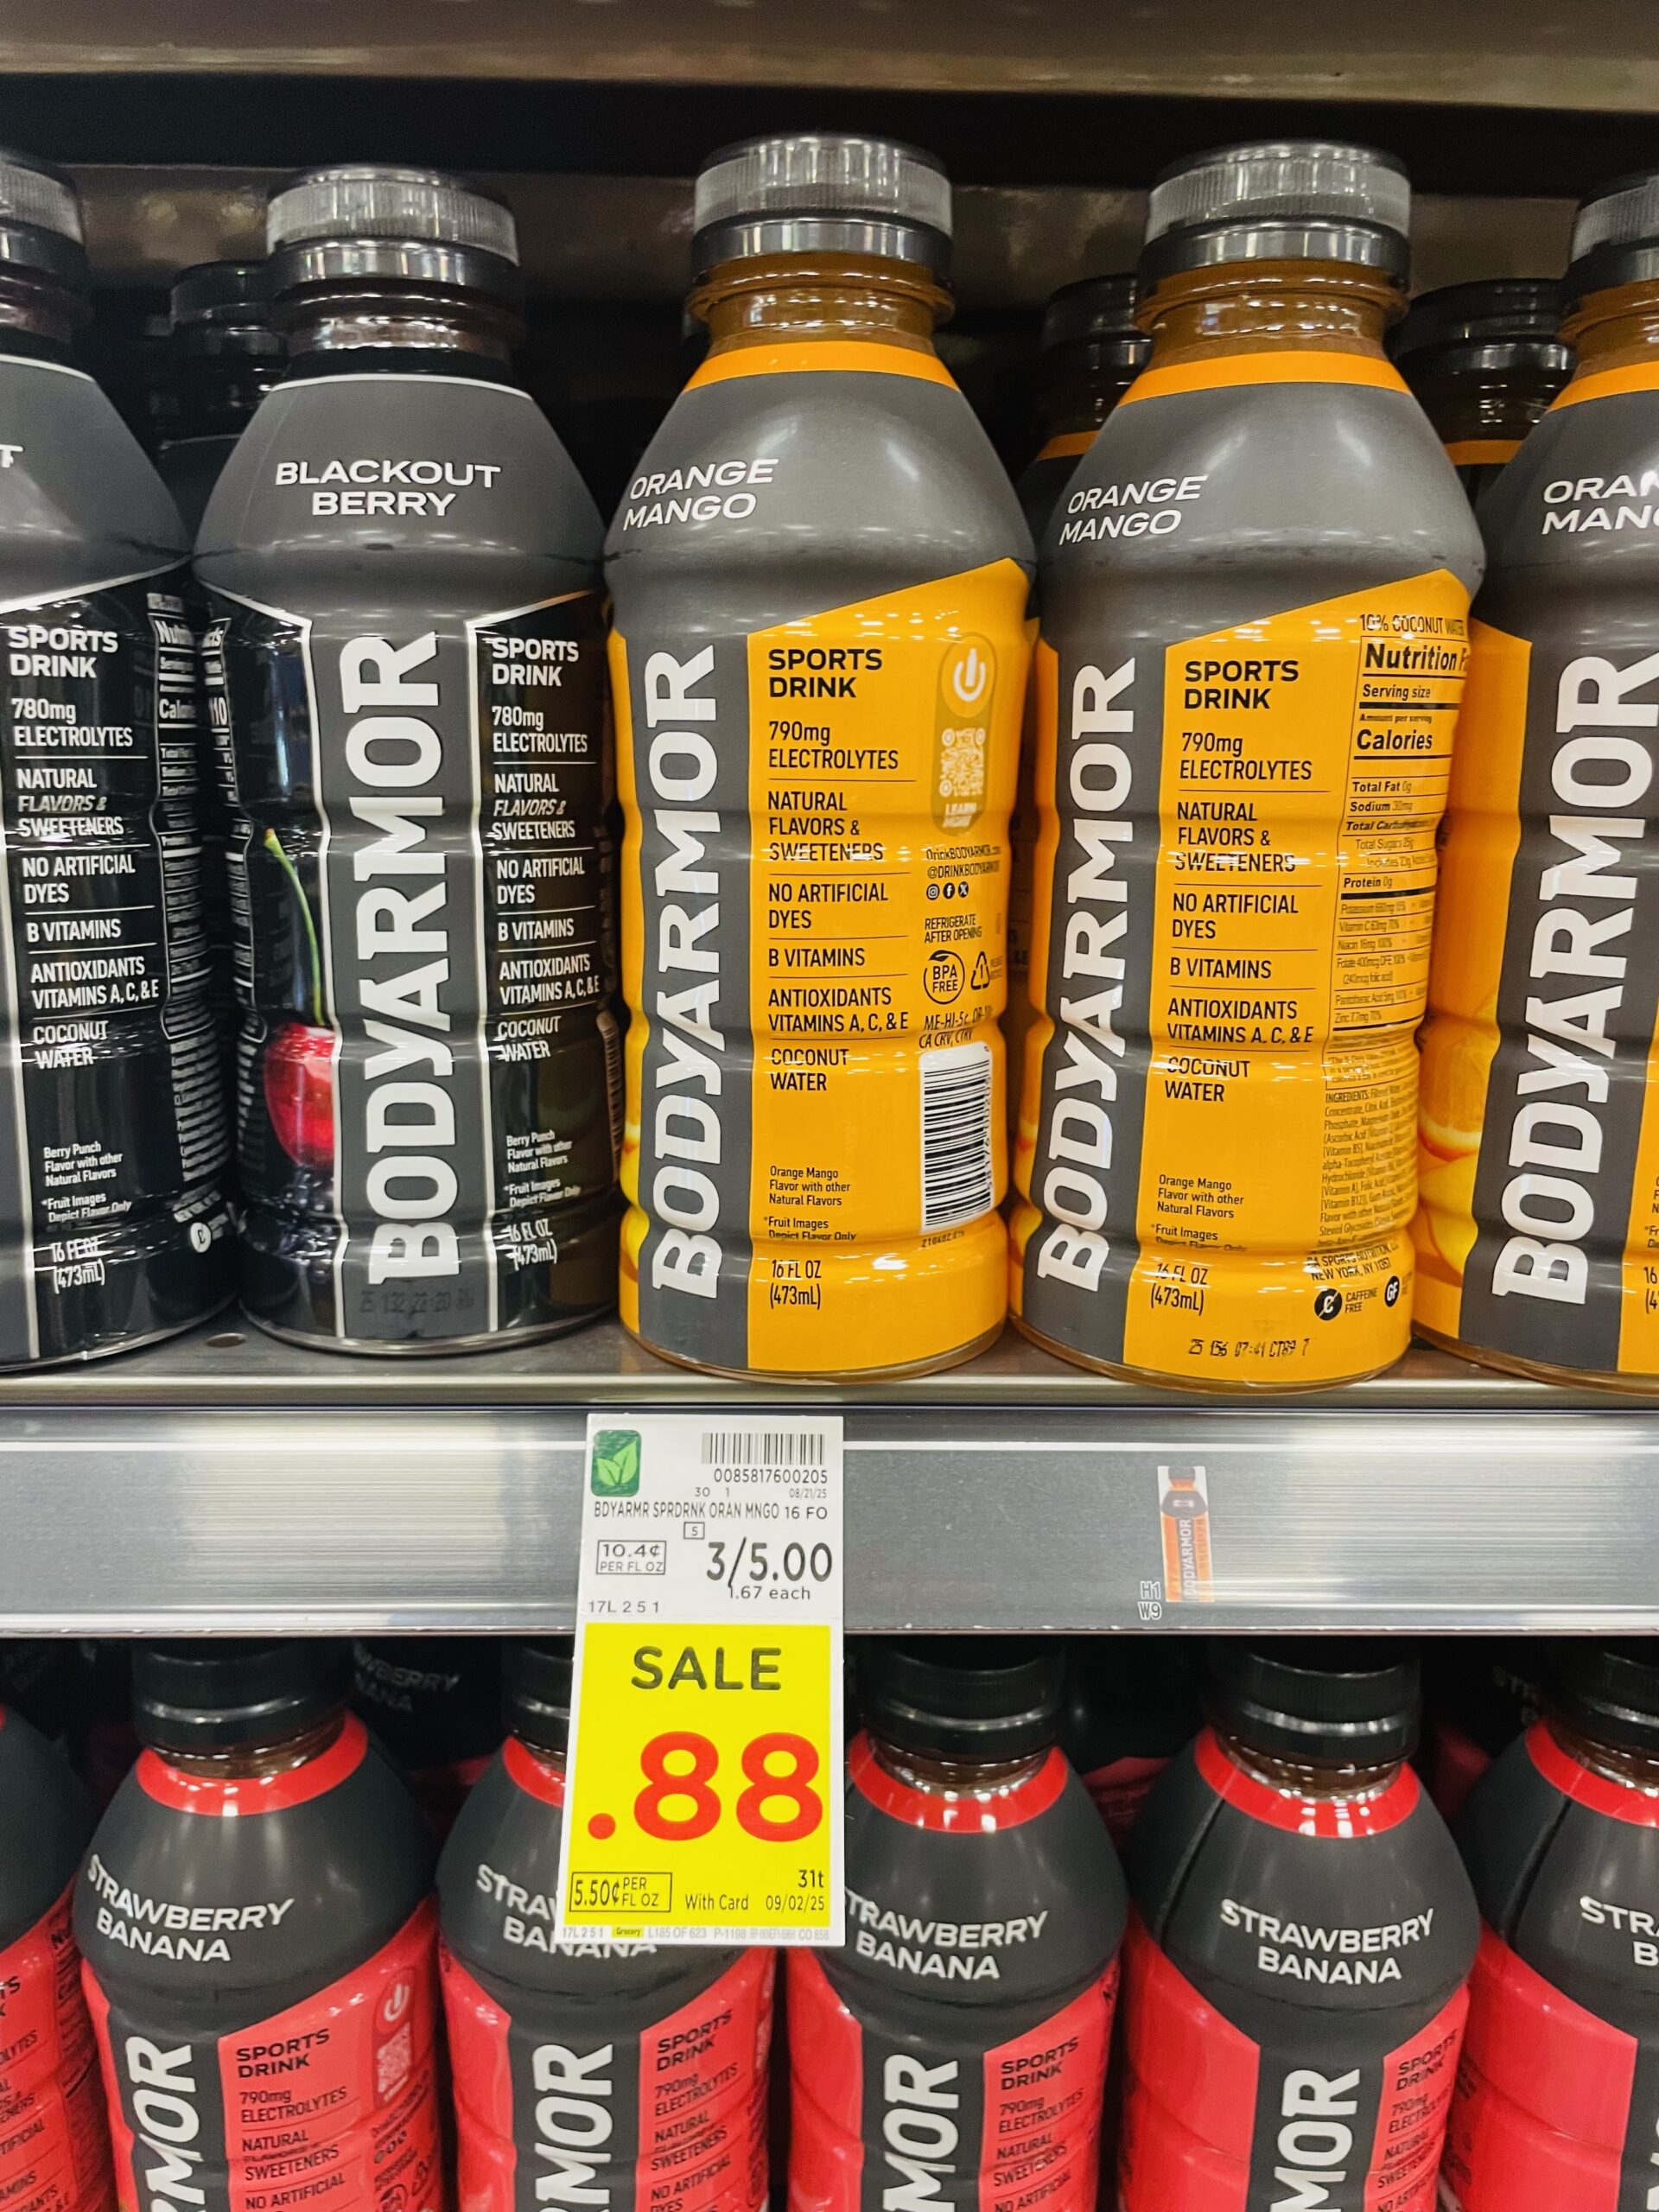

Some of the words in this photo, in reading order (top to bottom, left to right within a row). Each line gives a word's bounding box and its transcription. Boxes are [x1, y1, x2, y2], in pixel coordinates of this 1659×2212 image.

[276, 460, 501, 488] BLACKOUT
[630, 459, 779, 499] ORANGE
[1067, 475, 1208, 514] ORANGE
[1543, 474, 1659, 504] ORAN
[312, 492, 456, 516] BERRY
[623, 493, 757, 531] MANGO
[1058, 509, 1182, 546] MANGO
[7, 628, 118, 652] SPORTS
[492, 637, 579, 661] SPORTS
[10, 654, 97, 678] DRINK
[767, 648, 882, 671] SPORTS
[1364, 643, 1458, 671] Nutrition
[492, 664, 563, 687] DRINK
[1185, 659, 1299, 683] SPORTS
[769, 677, 857, 698] DRINK
[1363, 683, 1409, 701] Serving
[1412, 684, 1431, 698] size
[1184, 688, 1270, 709] DRINK
[11, 698, 76, 724] 780mg
[492, 706, 544, 731] 780mg
[14, 728, 133, 747] ELECTROLYTES
[493, 734, 588, 753] ELECTROLYTES
[768, 721, 831, 746] 790mg
[1357, 729, 1433, 750] Calories
[1181, 732, 1243, 757] 790mg
[768, 749, 899, 770] ELECTROLYTES
[1179, 760, 1312, 780] ELECTROLYTES
[16, 768, 97, 788] NATURAL
[494, 773, 559, 792] NATURAL
[1352, 781, 1382, 792] Total
[1384, 781, 1401, 791] Fat
[493, 800, 555, 817] FLAVORS
[767, 791, 848, 811] NATURAL
[1350, 802, 1390, 812] Sodium
[1177, 802, 1257, 822] NATURAL
[492, 821, 575, 841] SWEETENERS
[769, 818, 845, 836] FLAVORS
[849, 819, 860, 836] &
[1178, 828, 1254, 846] FLAVORS
[1259, 830, 1270, 846] &
[768, 842, 883, 861] SWEETENERS
[22, 857, 48, 878] NO
[54, 855, 136, 875] ARTIFICIAL
[497, 860, 519, 880] NO
[524, 857, 585, 878] ARTIFICIAL
[23, 883, 70, 904] DYES
[768, 884, 792, 903] NO
[797, 883, 888, 902] ARTIFICIAL
[1344, 878, 1381, 888] Protein
[496, 884, 535, 905] DYES
[1173, 893, 1198, 913] NO
[1203, 894, 1299, 914] ARTIFICIAL
[498, 922, 508, 942] B
[512, 918, 575, 940] VITAMINS
[768, 910, 812, 929] DYES
[925, 914, 976, 931] REFRIGERATE
[1172, 919, 1217, 939] DYES
[26, 923, 40, 943] B
[42, 918, 122, 942] VITAMINS
[925, 931, 950, 944] AFTER
[953, 926, 982, 942] OPENING
[340, 631, 461, 1285] BODYARMOR
[499, 954, 590, 980] ANTIOXIDANTS
[768, 949, 779, 967] B
[784, 948, 866, 967] VITAMINS
[1170, 957, 1180, 976] B
[1186, 958, 1272, 979] VITAMINS
[31, 957, 145, 982] ANTIOXIDANTS
[645, 645, 725, 1300] BODYARMOR
[932, 964, 957, 979] BPA
[1037, 657, 1135, 1294] BODYARMOR
[1491, 650, 1659, 1305] BODYARMOR
[768, 987, 892, 1007] ANTIOXIDANTS
[932, 980, 958, 993] FREE
[1167, 999, 1297, 1020] ANTIOXIDANTS
[768, 1013, 846, 1032] VITAMINS
[849, 1014, 865, 1033] A,
[868, 1014, 882, 1033] C,
[886, 1013, 896, 1030] &
[899, 1012, 908, 1029] E
[771, 1048, 849, 1066] COCONUT
[770, 1072, 827, 1091] WATER
[1165, 1080, 1225, 1103] WATER
[770, 1166, 803, 1180] Orange
[806, 1167, 838, 1180] Mango
[769, 1180, 798, 1192] Flavor
[802, 1181, 822, 1192] with
[824, 1181, 850, 1192] other
[769, 1194, 803, 1205] Natural
[807, 1195, 842, 1206] Flavors
[793, 1217, 829, 1230] Images
[772, 1260, 784, 1279] 16
[787, 1261, 802, 1279] FL
[805, 1261, 822, 1279] OZ
[770, 1282, 822, 1311] (473mL)
[1150, 1285, 1205, 1315] (473mL)
[1344, 1301, 1363, 1313] FREE
[714, 1469, 828, 1484] 0085817600205
[695, 1487, 710, 1497] 30
[789, 1489, 827, 1498] 08/21/25
[594, 1502, 650, 1518] BDYARMR
[653, 1502, 706, 1518] SPRDRNK
[709, 1503, 741, 1518] ORAN
[746, 1503, 779, 1519] MNGO
[785, 1507, 800, 1519] 16
[806, 1507, 828, 1519] FO
[600, 1561, 623, 1572] PER
[627, 1561, 641, 1572] FL
[645, 1562, 664, 1573] OZ
[602, 1543, 660, 1557] 10.4¢
[706, 1537, 833, 1588] 3/5.00
[729, 1586, 762, 1599] 1.67
[769, 1586, 810, 1600] each
[588, 1601, 617, 1613] 17L
[623, 1602, 632, 1613] 2
[638, 1602, 645, 1613] 5
[653, 1603, 659, 1613] 1
[1138, 1601, 1161, 1620] W9
[631, 1645, 781, 1690] SALE
[588, 1730, 823, 1842] .88
[798, 1870, 824, 1889] 31t
[87, 1853, 295, 1932] STRAWBERRY
[574, 1879, 620, 1907] 5.50¢
[622, 1877, 646, 1891] PER
[622, 1893, 636, 1906] FL
[641, 1893, 658, 1907] OZ
[685, 1894, 715, 1910] With
[719, 1894, 748, 1910] Card
[766, 1895, 824, 1913] 09/02/25
[845, 1887, 1049, 1948] TRAWBERRY
[1220, 1899, 1434, 1954] STRAWBERRY
[96, 1907, 231, 1962] BANANA
[563, 1928, 579, 1937] 17L
[616, 1927, 640, 1936] Grocery
[673, 1929, 687, 1937] OF
[856, 1930, 1000, 1980] BANANA
[1257, 1947, 1402, 1984] BANANA
[657, 2009, 734, 2054] SPORTS
[236, 2028, 330, 2063] SPORTS
[657, 2039, 716, 2070] DRINK
[1001, 2037, 1078, 2074] SPORTS
[238, 2054, 311, 2079] DRINK
[1001, 2062, 1063, 2091] DRINK
[239, 2088, 292, 2105] 790mg
[240, 2087, 347, 2123] ELECTROLYTES
[242, 2130, 309, 2152] NATURAL
[245, 2146, 340, 2181] SWEETENERS
